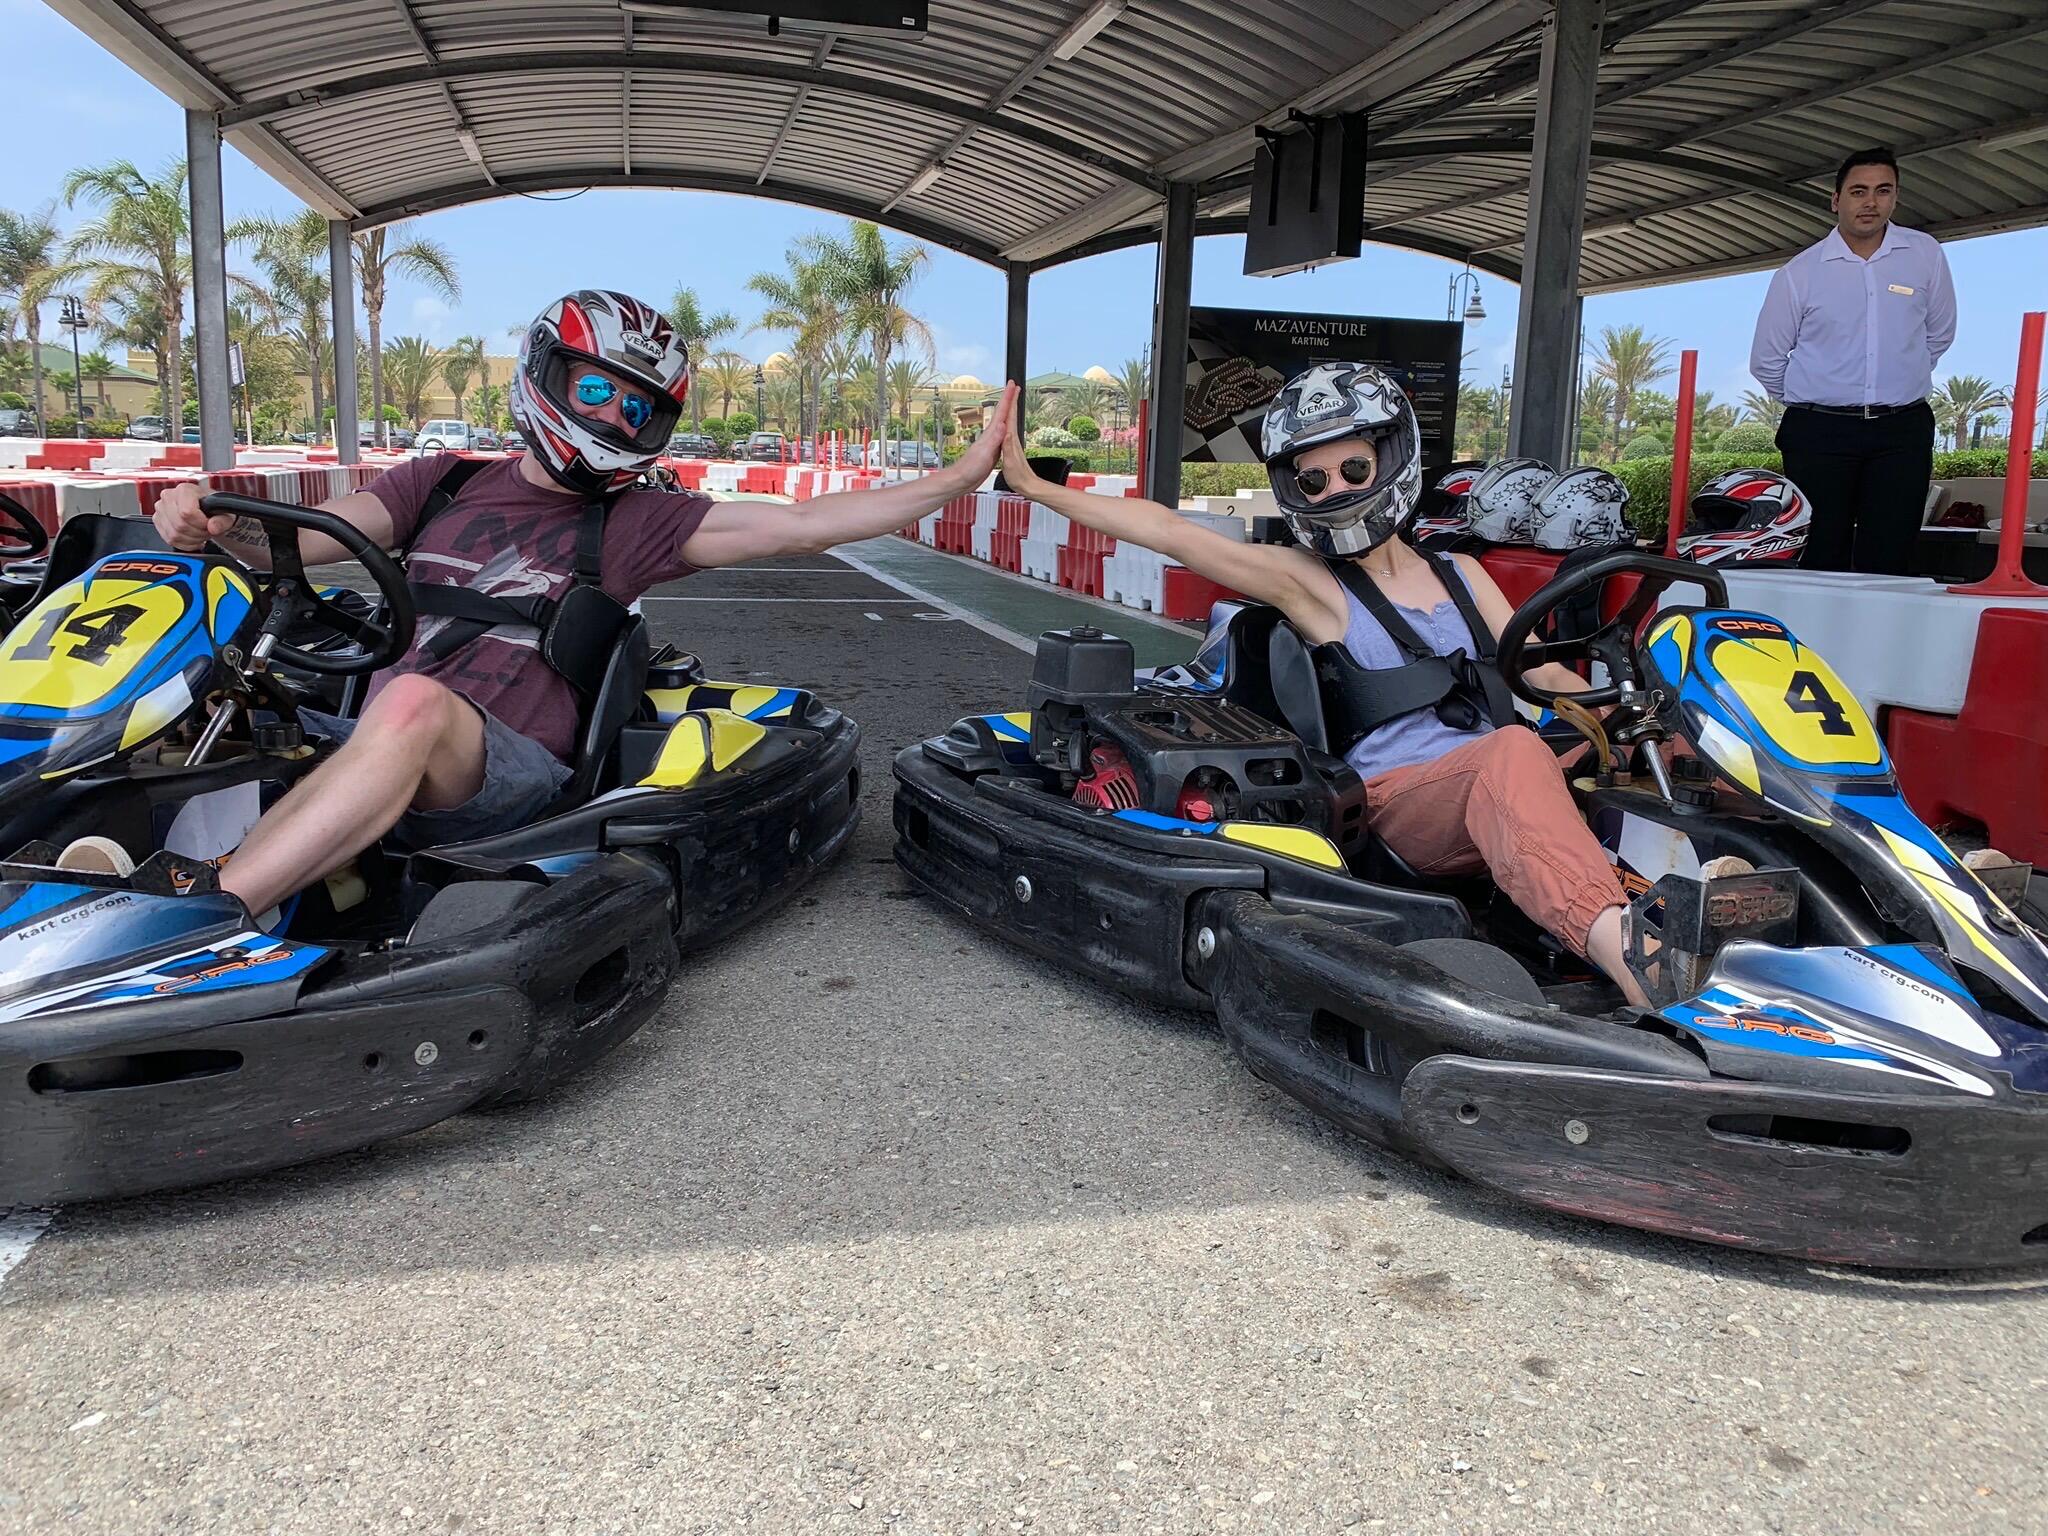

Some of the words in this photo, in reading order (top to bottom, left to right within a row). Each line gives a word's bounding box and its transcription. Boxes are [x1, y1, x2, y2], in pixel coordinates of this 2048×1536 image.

[625, 333, 663, 358] VEMAR
[1254, 318, 1368, 337] MAZ'AVENTURE
[1291, 335, 1330, 347] KARTING
[1299, 400, 1341, 417] VEMAR
[9, 602, 148, 667] 14
[1783, 670, 1856, 737] 4
[17, 919, 57, 942] kart
[59, 893, 132, 926] crg.com
[1842, 948, 1877, 970] kart
[1879, 965, 1946, 1006] crg.com
